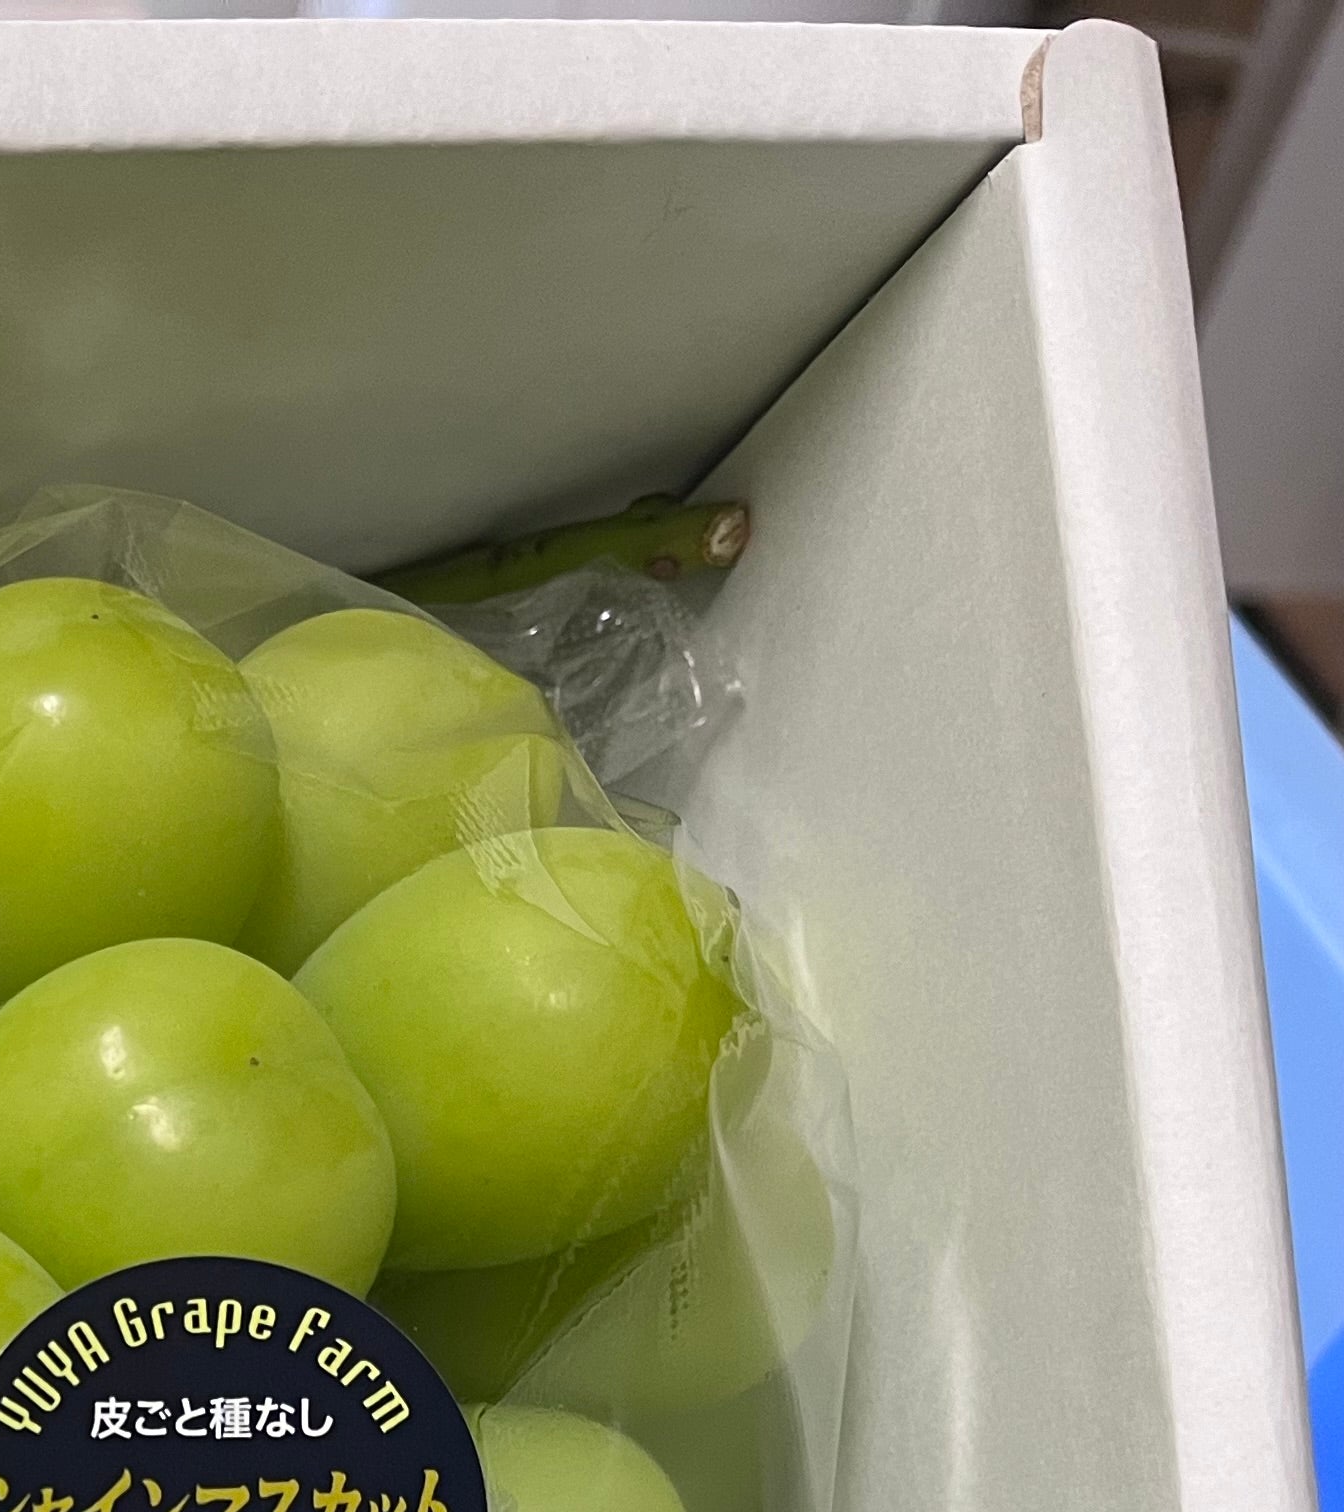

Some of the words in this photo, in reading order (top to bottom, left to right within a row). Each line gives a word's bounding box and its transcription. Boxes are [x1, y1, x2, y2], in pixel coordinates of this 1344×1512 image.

[113, 1296, 276, 1349] Grape
[288, 1307, 410, 1435] Farm
[90, 1396, 334, 1440] 皮ごと種なし
